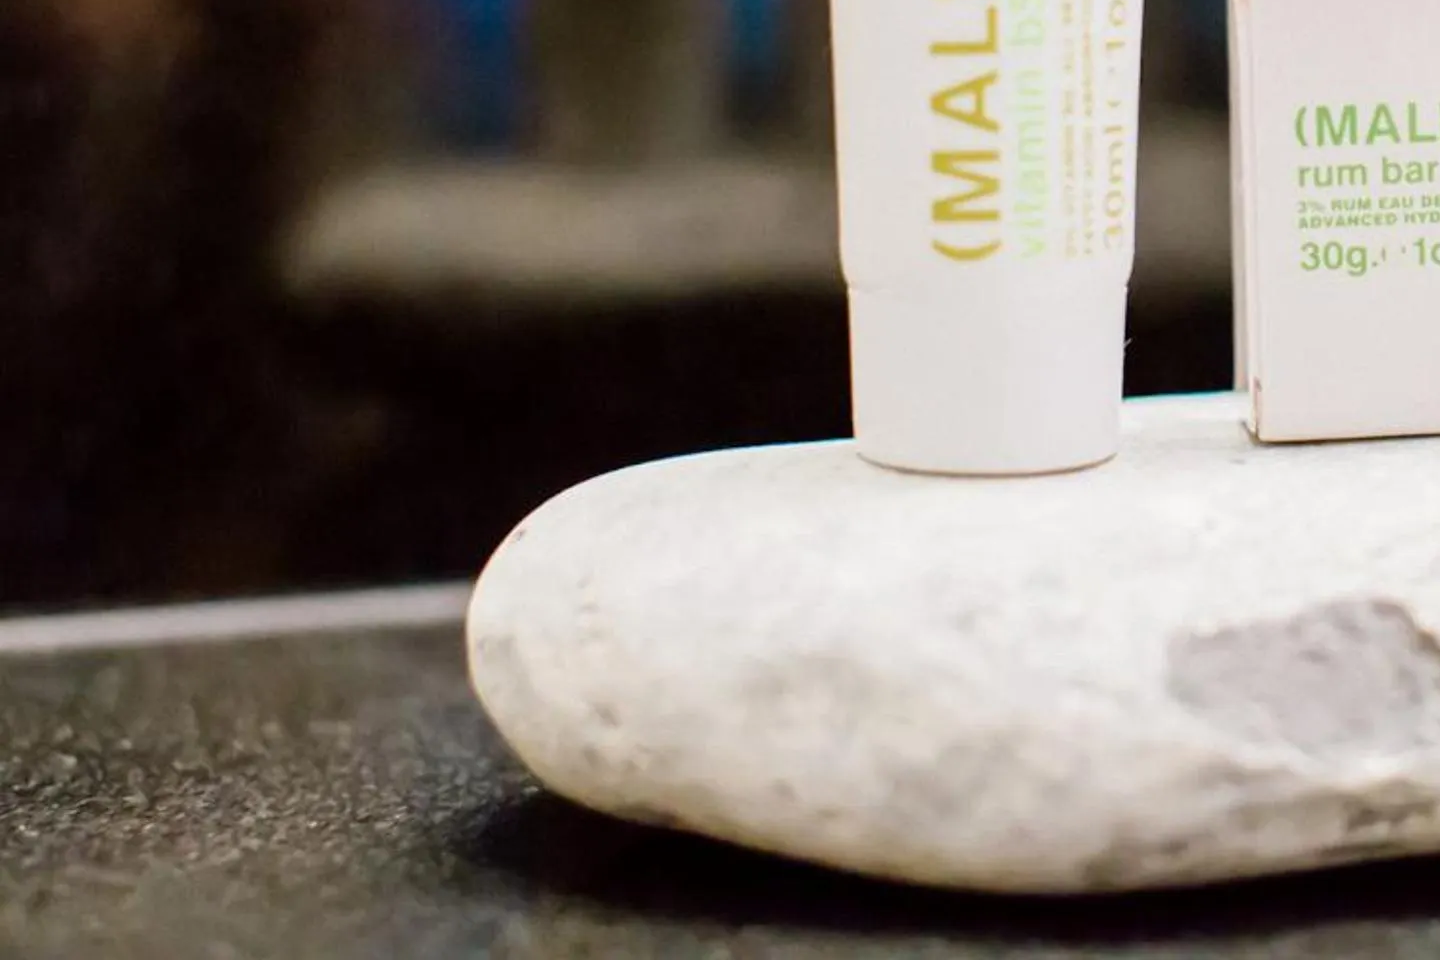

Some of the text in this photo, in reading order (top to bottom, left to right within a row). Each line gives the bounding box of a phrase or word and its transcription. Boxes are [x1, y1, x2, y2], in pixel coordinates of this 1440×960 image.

[1009, 69, 1047, 258] vitamin
[1298, 163, 1368, 188] rum
[1381, 156, 1439, 186] bar
[1331, 198, 1372, 211] RUM
[1379, 196, 1414, 209] EAU
[1298, 212, 1398, 229] ADVANCED
